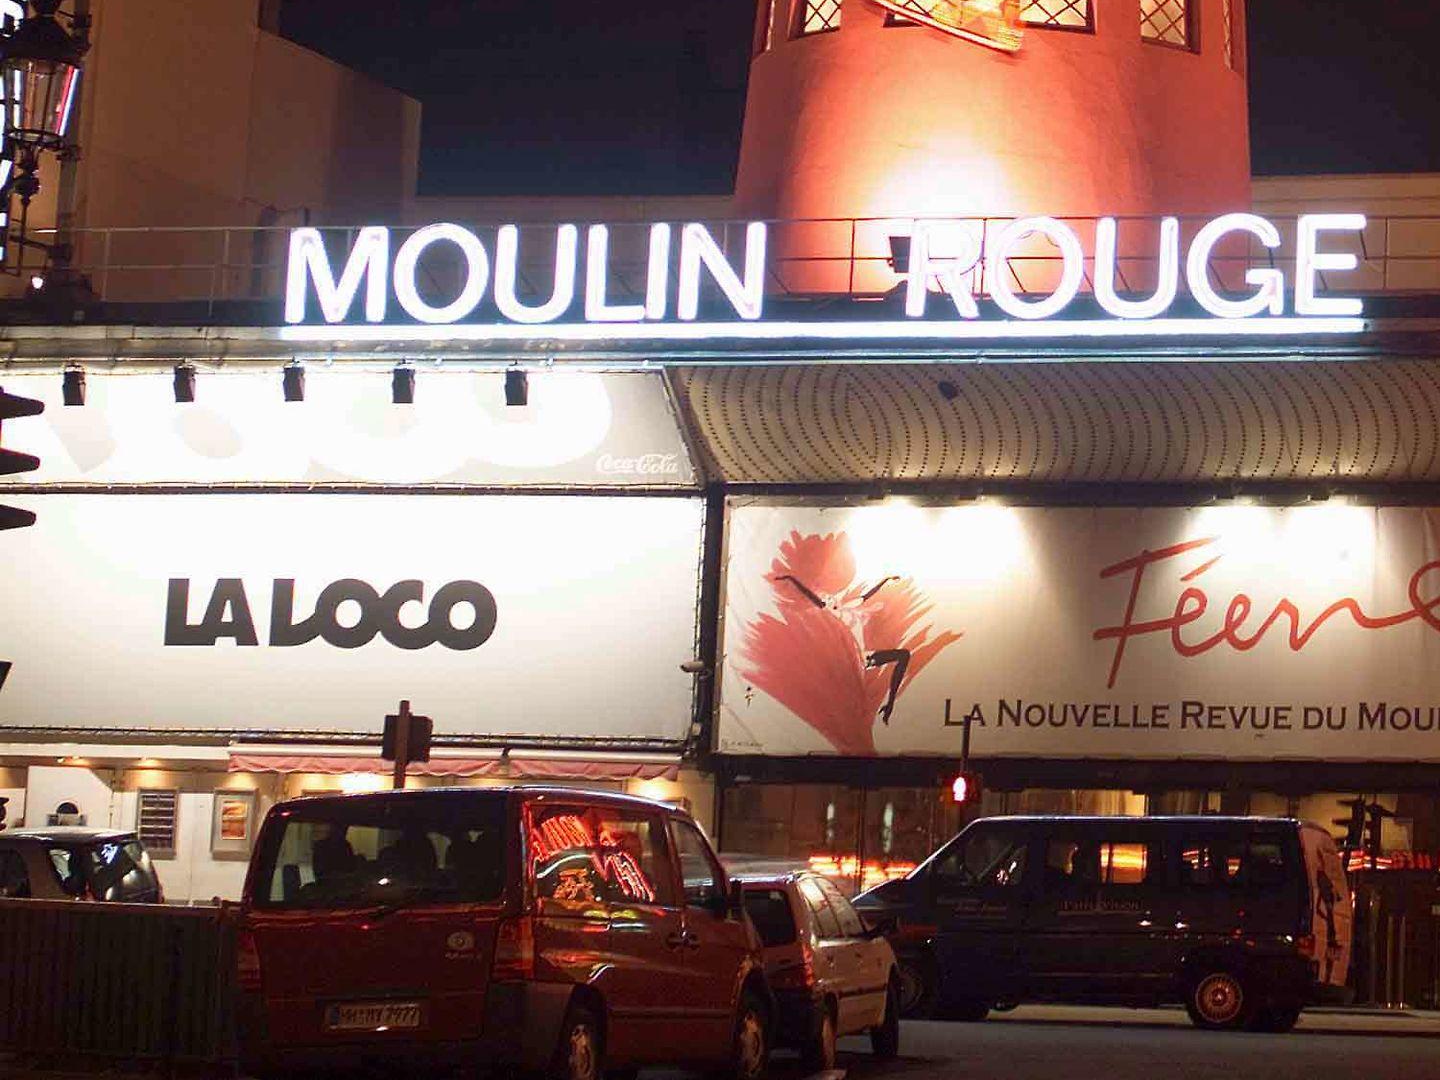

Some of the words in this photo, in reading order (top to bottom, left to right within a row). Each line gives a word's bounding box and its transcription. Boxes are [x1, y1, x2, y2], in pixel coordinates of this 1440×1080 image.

[284, 222, 767, 324] MOULIN
[904, 213, 1367, 319] ROUGE
[595, 453, 679, 475] Coca-Cola
[996, 699, 1170, 730] NOUVELLE
[1180, 700, 1293, 731] REVUE
[1302, 705, 1348, 731] DU
